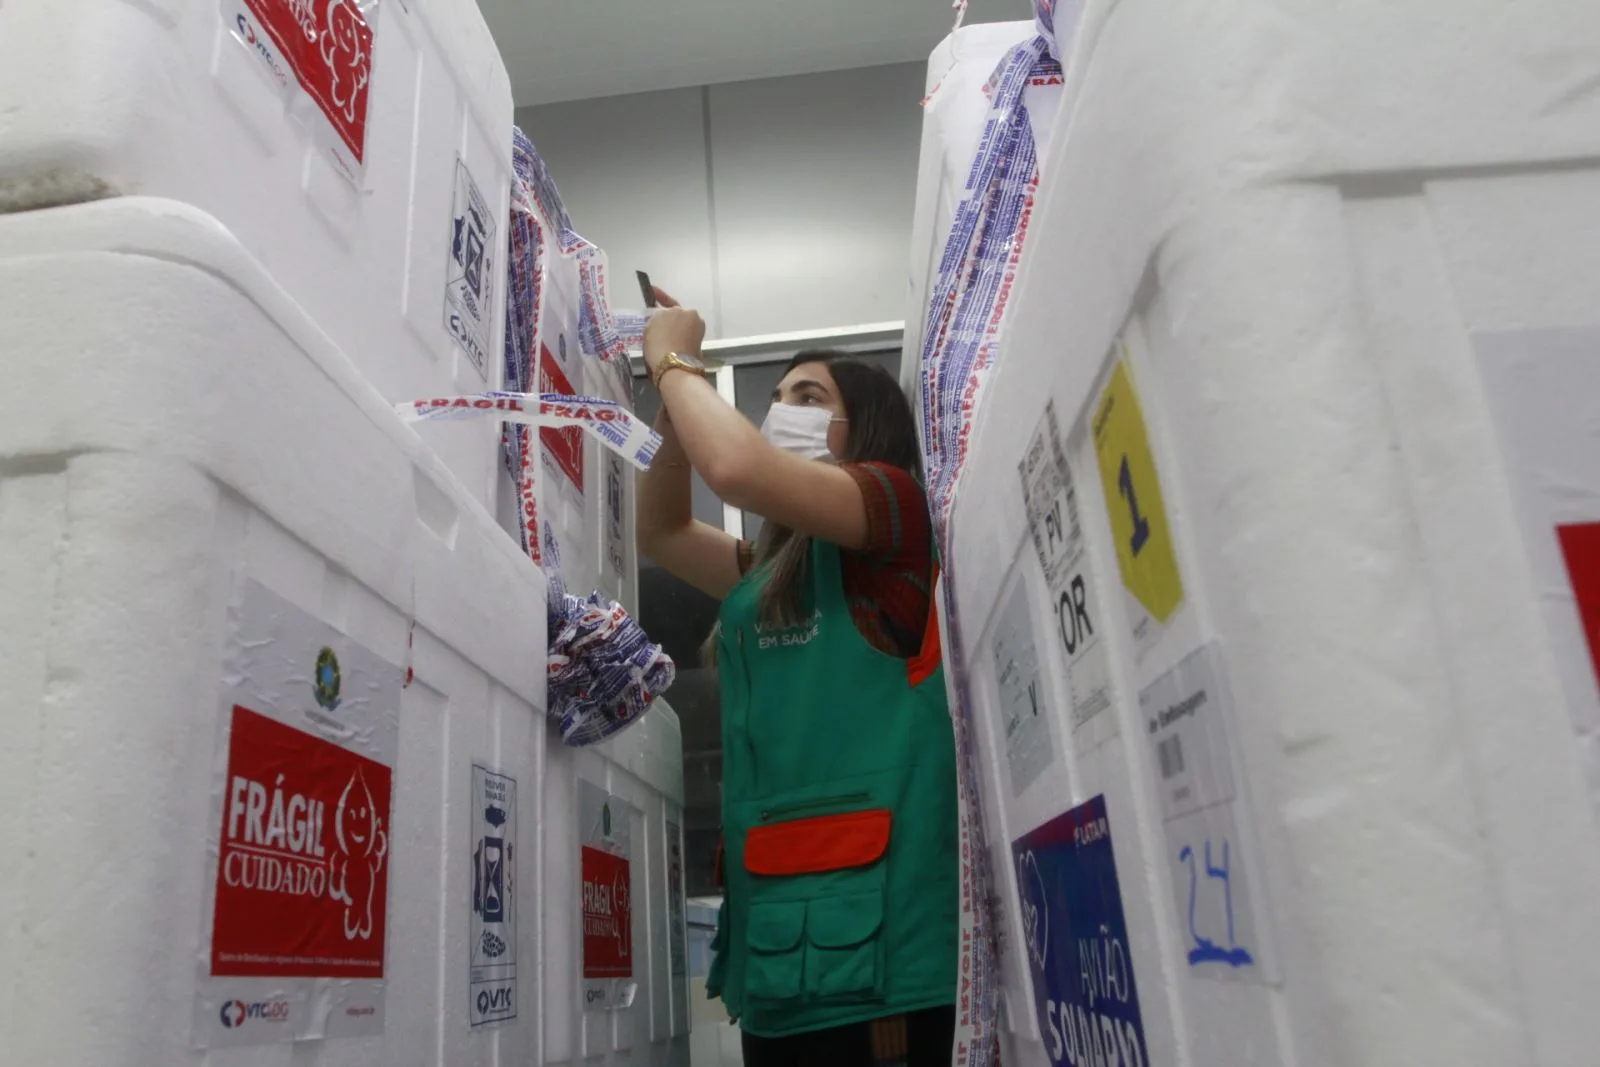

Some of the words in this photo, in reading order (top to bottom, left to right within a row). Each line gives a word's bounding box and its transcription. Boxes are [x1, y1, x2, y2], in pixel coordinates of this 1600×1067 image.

[758, 637, 779, 649] EM
[227, 773, 325, 857] FRÁGIL
[224, 850, 326, 898] CUIDADO
[583, 876, 612, 915] FRÁGIL
[1079, 923, 1129, 1003] AVIÃO
[247, 1002, 289, 1021] VTCLOG
